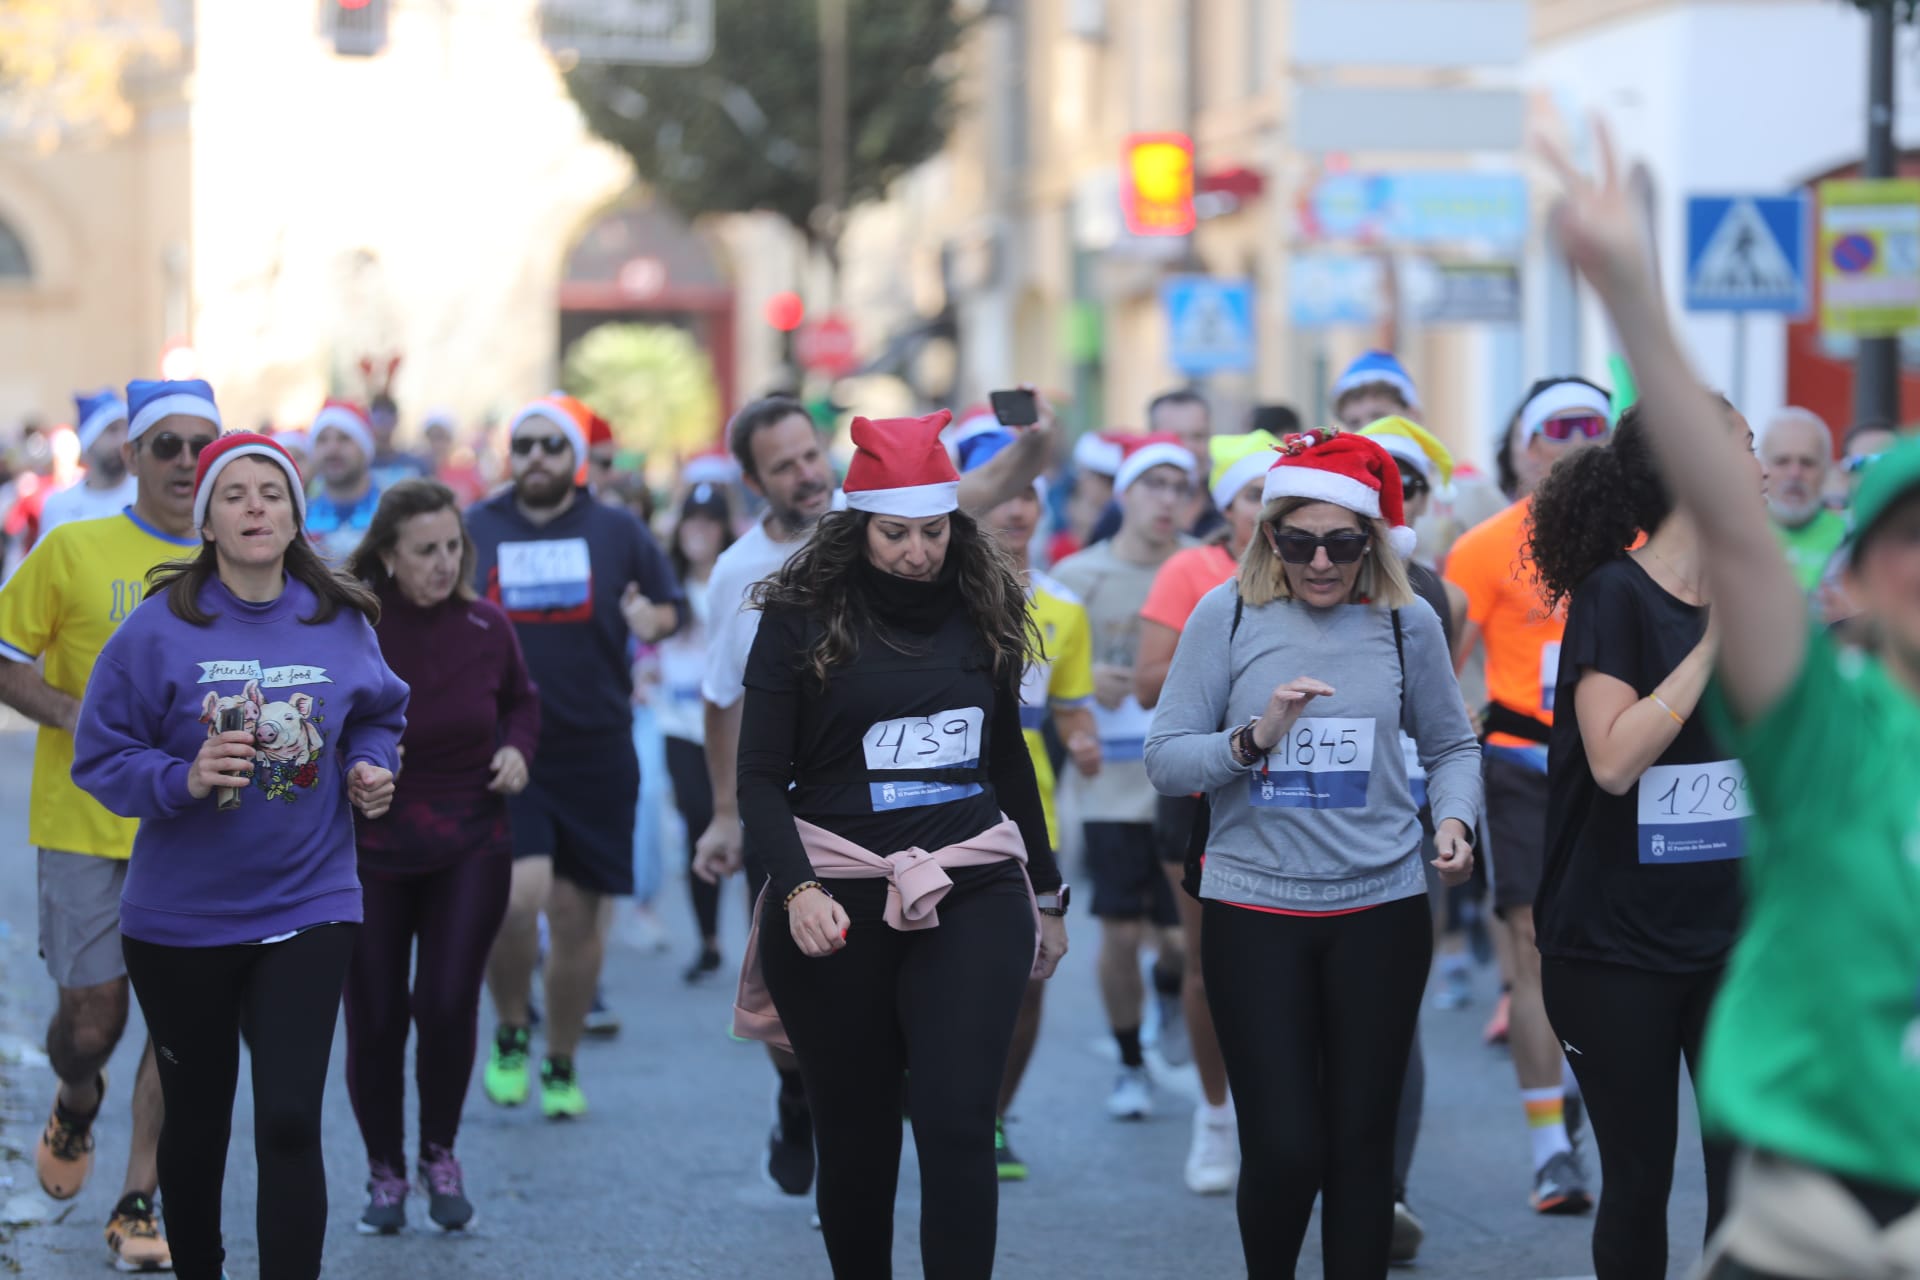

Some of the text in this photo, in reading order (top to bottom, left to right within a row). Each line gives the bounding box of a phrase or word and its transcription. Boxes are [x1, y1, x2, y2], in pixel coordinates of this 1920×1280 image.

[287, 668, 312, 684] food
[876, 719, 969, 764] 439
[1284, 727, 1359, 766] 1845
[1271, 875, 1313, 901] life
[1322, 875, 1393, 901] enjoy
